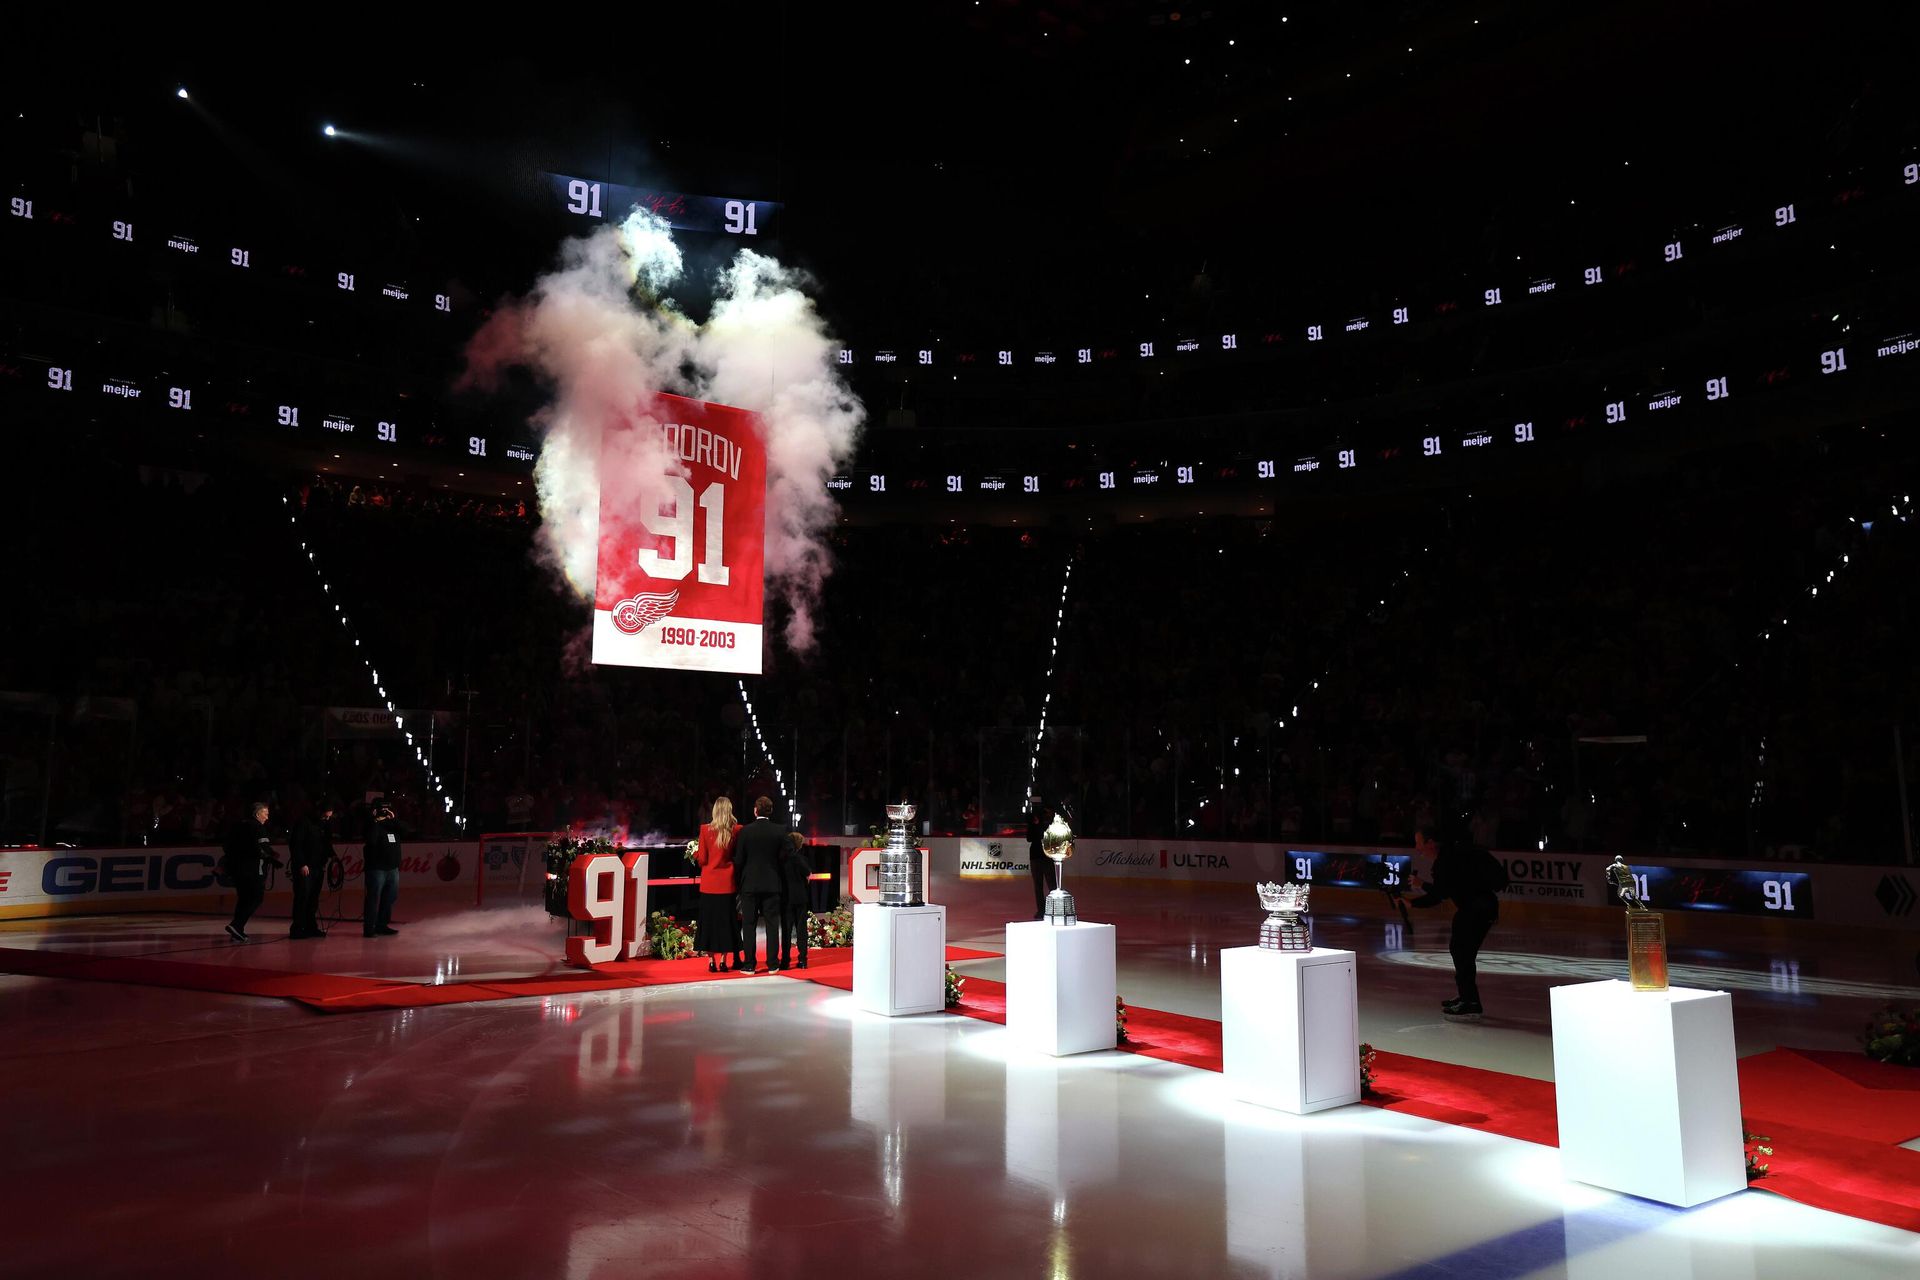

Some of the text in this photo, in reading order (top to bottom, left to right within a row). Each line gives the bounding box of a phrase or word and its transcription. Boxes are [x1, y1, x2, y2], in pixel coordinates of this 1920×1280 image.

[567, 180, 601, 217] 91
[11, 198, 32, 219] 91
[1776, 204, 1795, 226] 91
[724, 201, 758, 235] 91
[113, 221, 132, 241] 91
[1713, 229, 1742, 243] meijer
[168, 237, 199, 252] meijer
[1665, 242, 1682, 262] 91
[232, 248, 249, 267] 91
[338, 273, 354, 291] 91
[1585, 267, 1602, 284] 91
[383, 286, 408, 299] meijer
[1529, 283, 1555, 293] meijer
[436, 295, 450, 312] 91
[1485, 288, 1501, 305] 91
[1394, 308, 1408, 324] 91
[1308, 325, 1322, 340] 91
[1346, 320, 1368, 331] meijer
[1140, 343, 1154, 357] 91
[1177, 343, 1199, 351] meijer
[1223, 335, 1236, 349] 91
[839, 349, 853, 363] 91
[876, 354, 896, 362] meijer
[919, 351, 932, 364] 91
[999, 351, 1012, 364] 91
[1035, 353, 1056, 363] meijer
[1079, 349, 1091, 363] 91
[1821, 348, 1846, 373] 91
[48, 368, 72, 391] 91
[103, 382, 141, 397] meijer
[1707, 377, 1728, 400] 91
[169, 388, 191, 409] 91
[1649, 396, 1681, 410] meijer
[278, 406, 298, 426] 91
[1606, 402, 1625, 423] 91
[323, 417, 354, 432] meijer
[378, 422, 396, 442] 91
[1515, 423, 1534, 442] 91
[469, 437, 486, 456] 91
[1424, 437, 1441, 455] 91
[1463, 435, 1492, 446] meijer
[507, 450, 533, 460] meijer
[1339, 450, 1355, 468] 91
[1258, 461, 1275, 478] 91
[1295, 461, 1319, 471] meijer
[871, 475, 885, 491] 91
[1100, 472, 1115, 488] 91
[1134, 474, 1158, 484] meijer
[1178, 467, 1193, 483] 91
[826, 480, 852, 490] meijer
[947, 476, 962, 491] 91
[981, 481, 1005, 490] meijer
[1024, 476, 1039, 492] 91
[638, 474, 729, 586] 91
[661, 627, 735, 649] 1990-2003
[1173, 854, 1229, 869] ULTRA
[1296, 858, 1312, 879] 91
[42, 855, 238, 895] GEIC
[1537, 887, 1584, 898] OPERATE
[1763, 880, 1795, 911] 91
[566, 852, 650, 967] 91
